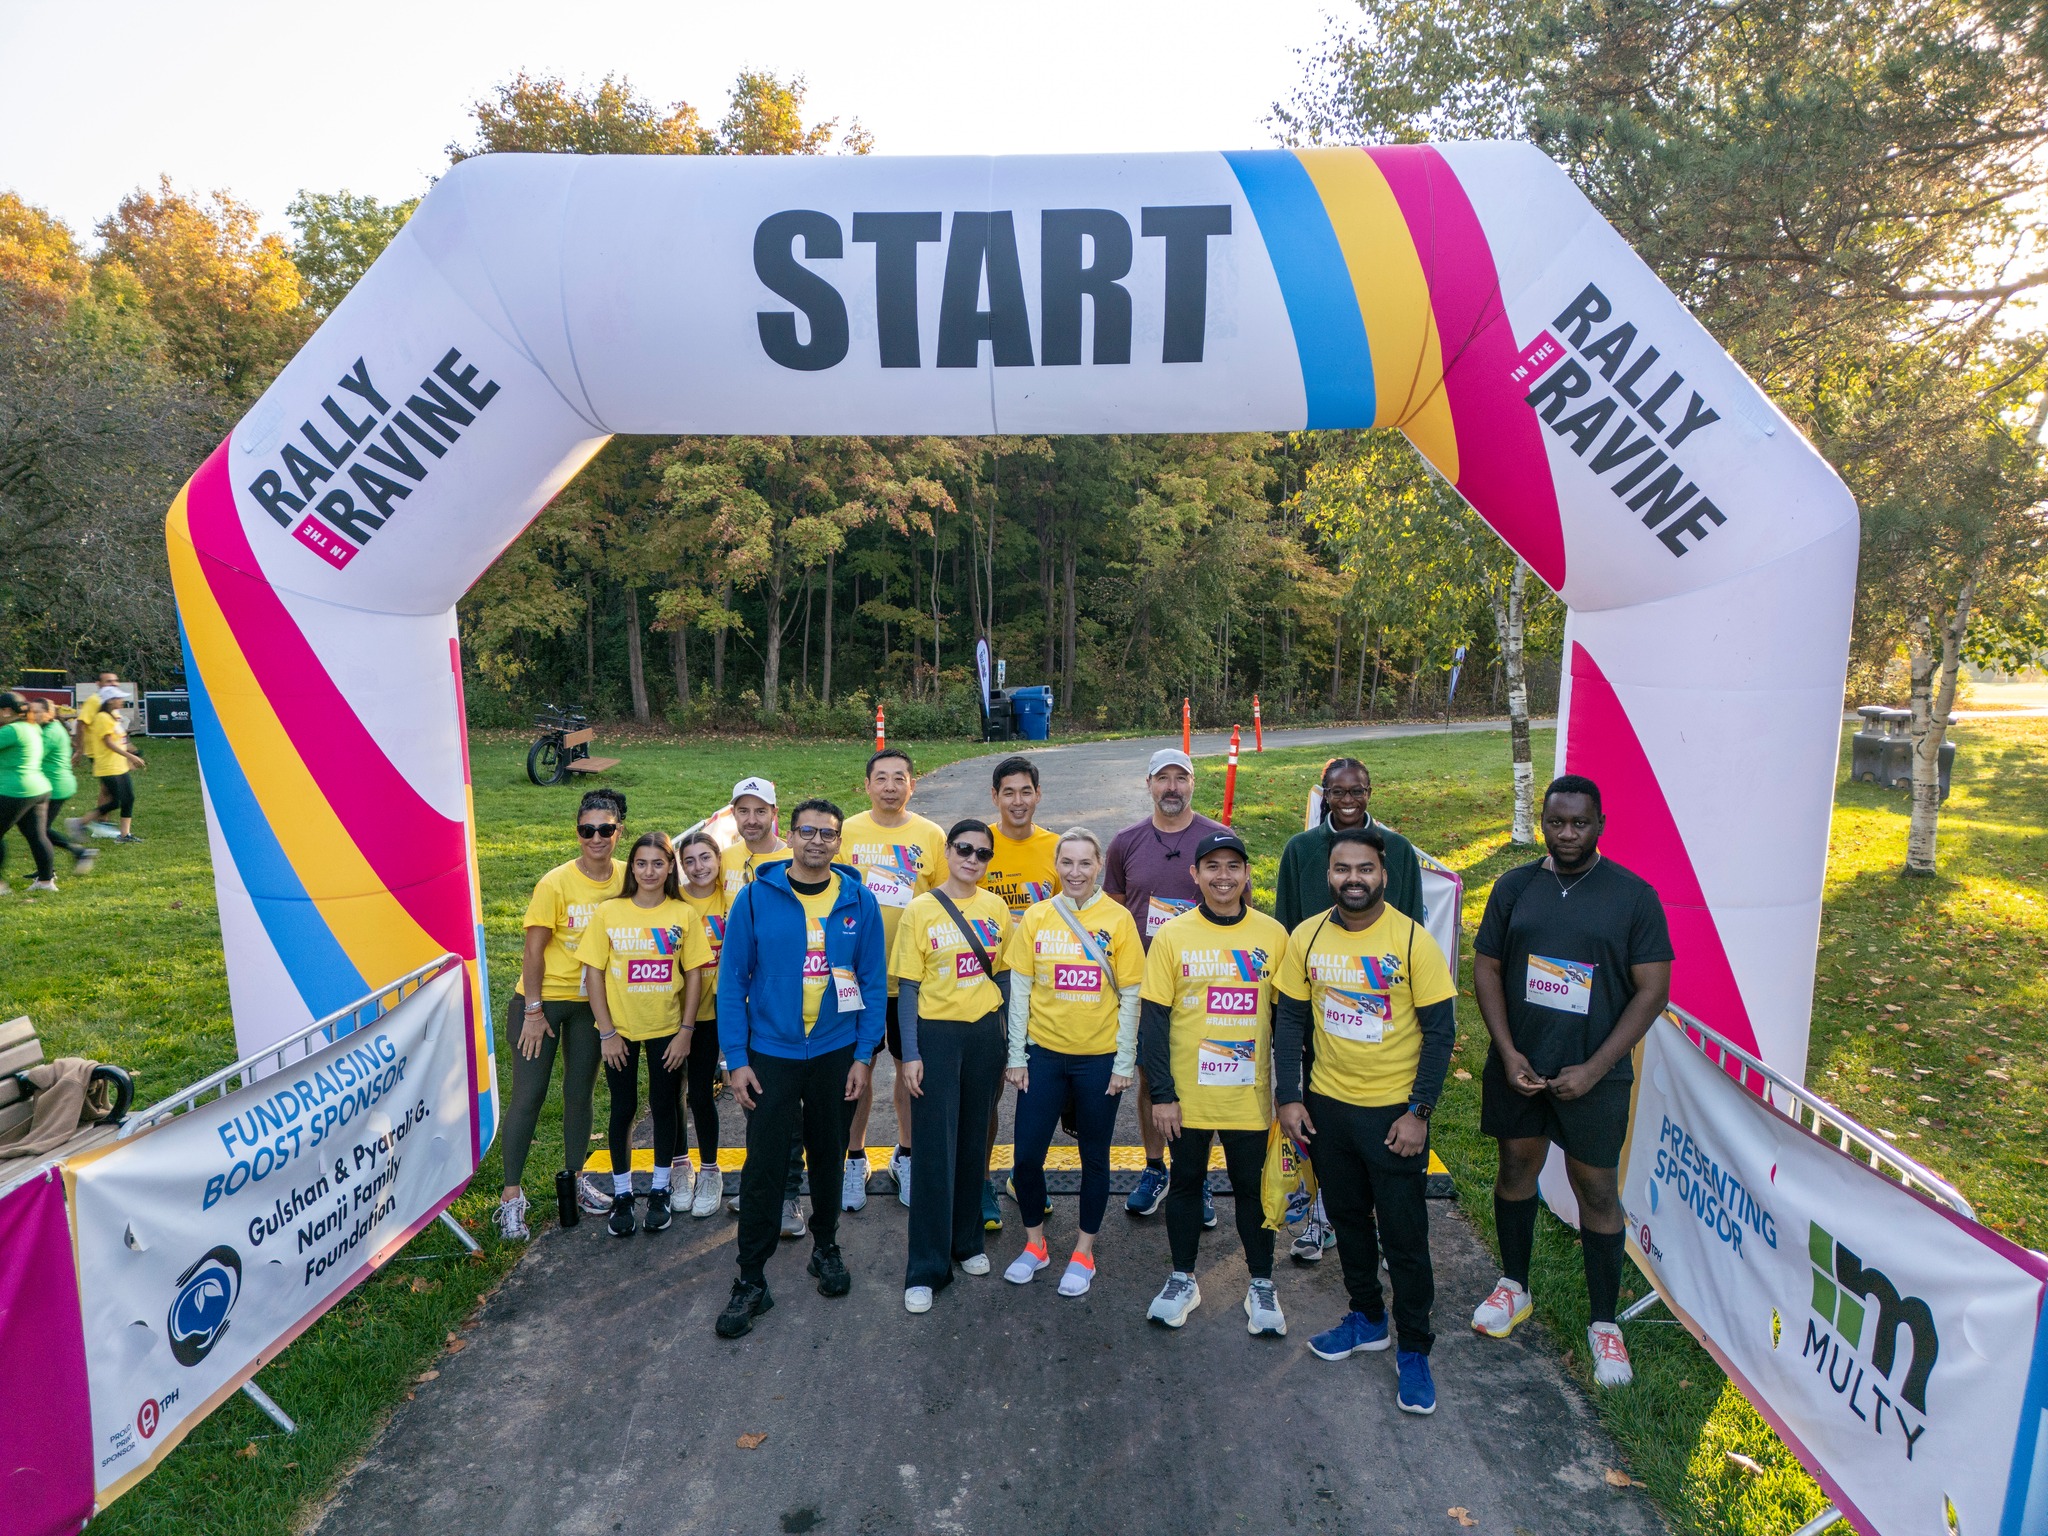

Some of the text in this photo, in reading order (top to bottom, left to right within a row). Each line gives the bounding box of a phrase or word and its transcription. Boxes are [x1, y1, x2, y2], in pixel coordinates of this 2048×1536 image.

[753, 205, 1232, 371] START
[1510, 342, 1555, 382] IN THE
[1552, 282, 1721, 450] RALLY
[248, 355, 392, 529] RALLY
[314, 346, 501, 546] RAVINE
[1524, 357, 1728, 558] RAVINE
[302, 524, 348, 560] IN THE
[853, 843, 884, 854] RALLY
[858, 854, 896, 866] RAVINE
[867, 882, 899, 895] #0479
[988, 883, 1018, 896] RALLY
[1002, 893, 1031, 906] AVINE
[606, 927, 642, 940] RALLY
[1036, 929, 1071, 942] RALLY
[613, 939, 655, 951] RAVINE
[1041, 942, 1082, 955] RAVINE
[1181, 949, 1221, 963] RALLY
[1310, 953, 1350, 968] RALLY
[631, 964, 669, 979] 2025
[1058, 969, 1098, 987] 2025
[1188, 963, 1237, 977] RAVINE
[1317, 968, 1365, 984] RAVINE
[1529, 979, 1569, 995] #0890
[1055, 992, 1101, 1002] #RALLY4NYG
[1210, 991, 1254, 1011] 2025
[1205, 1016, 1257, 1026] #RALLY4NYG
[1326, 1009, 1363, 1026] #0175
[1201, 1061, 1239, 1072] #0177
[217, 1034, 396, 1159] FUNDRAISING
[202, 1056, 408, 1212] BOOST SPONSOR
[248, 1099, 431, 1247] Gulshan & Pyarali G.
[1659, 1114, 1778, 1250] PRESENTING
[298, 1155, 402, 1255] Nanji Family
[1653, 1148, 1744, 1260] SPONSOR
[305, 1194, 396, 1287] Foundation
[1651, 1242, 1663, 1263] TPH
[1802, 1318, 1926, 1462] MULTY
[159, 1387, 179, 1413] TPH
[109, 1423, 132, 1443] PROUD
[115, 1432, 133, 1449] PRINT
[102, 1441, 136, 1468] SPONSOR
